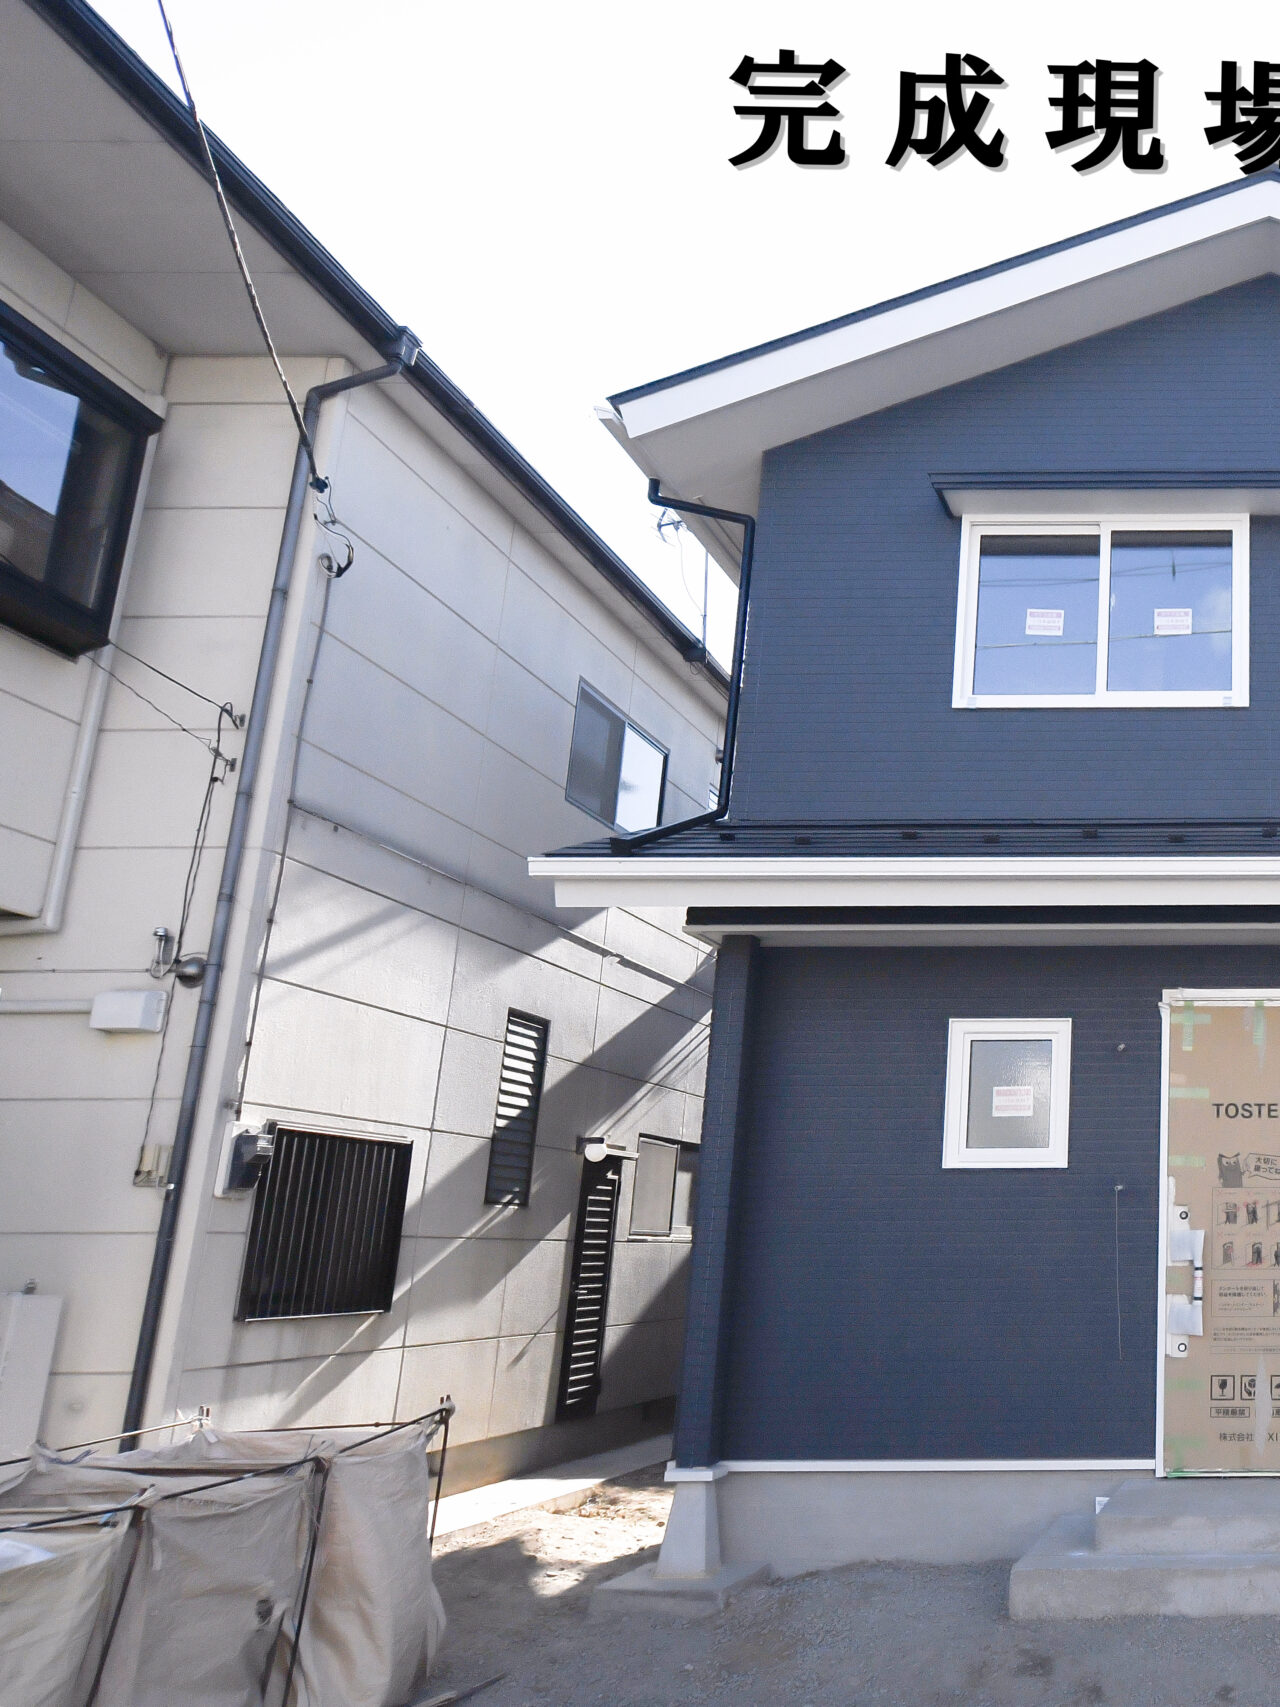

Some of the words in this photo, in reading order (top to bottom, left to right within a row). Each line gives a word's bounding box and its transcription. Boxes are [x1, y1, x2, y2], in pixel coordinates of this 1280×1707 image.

[1255, 1157, 1278, 1166] 大切に
[1219, 1432, 1254, 1442] 株式会社
